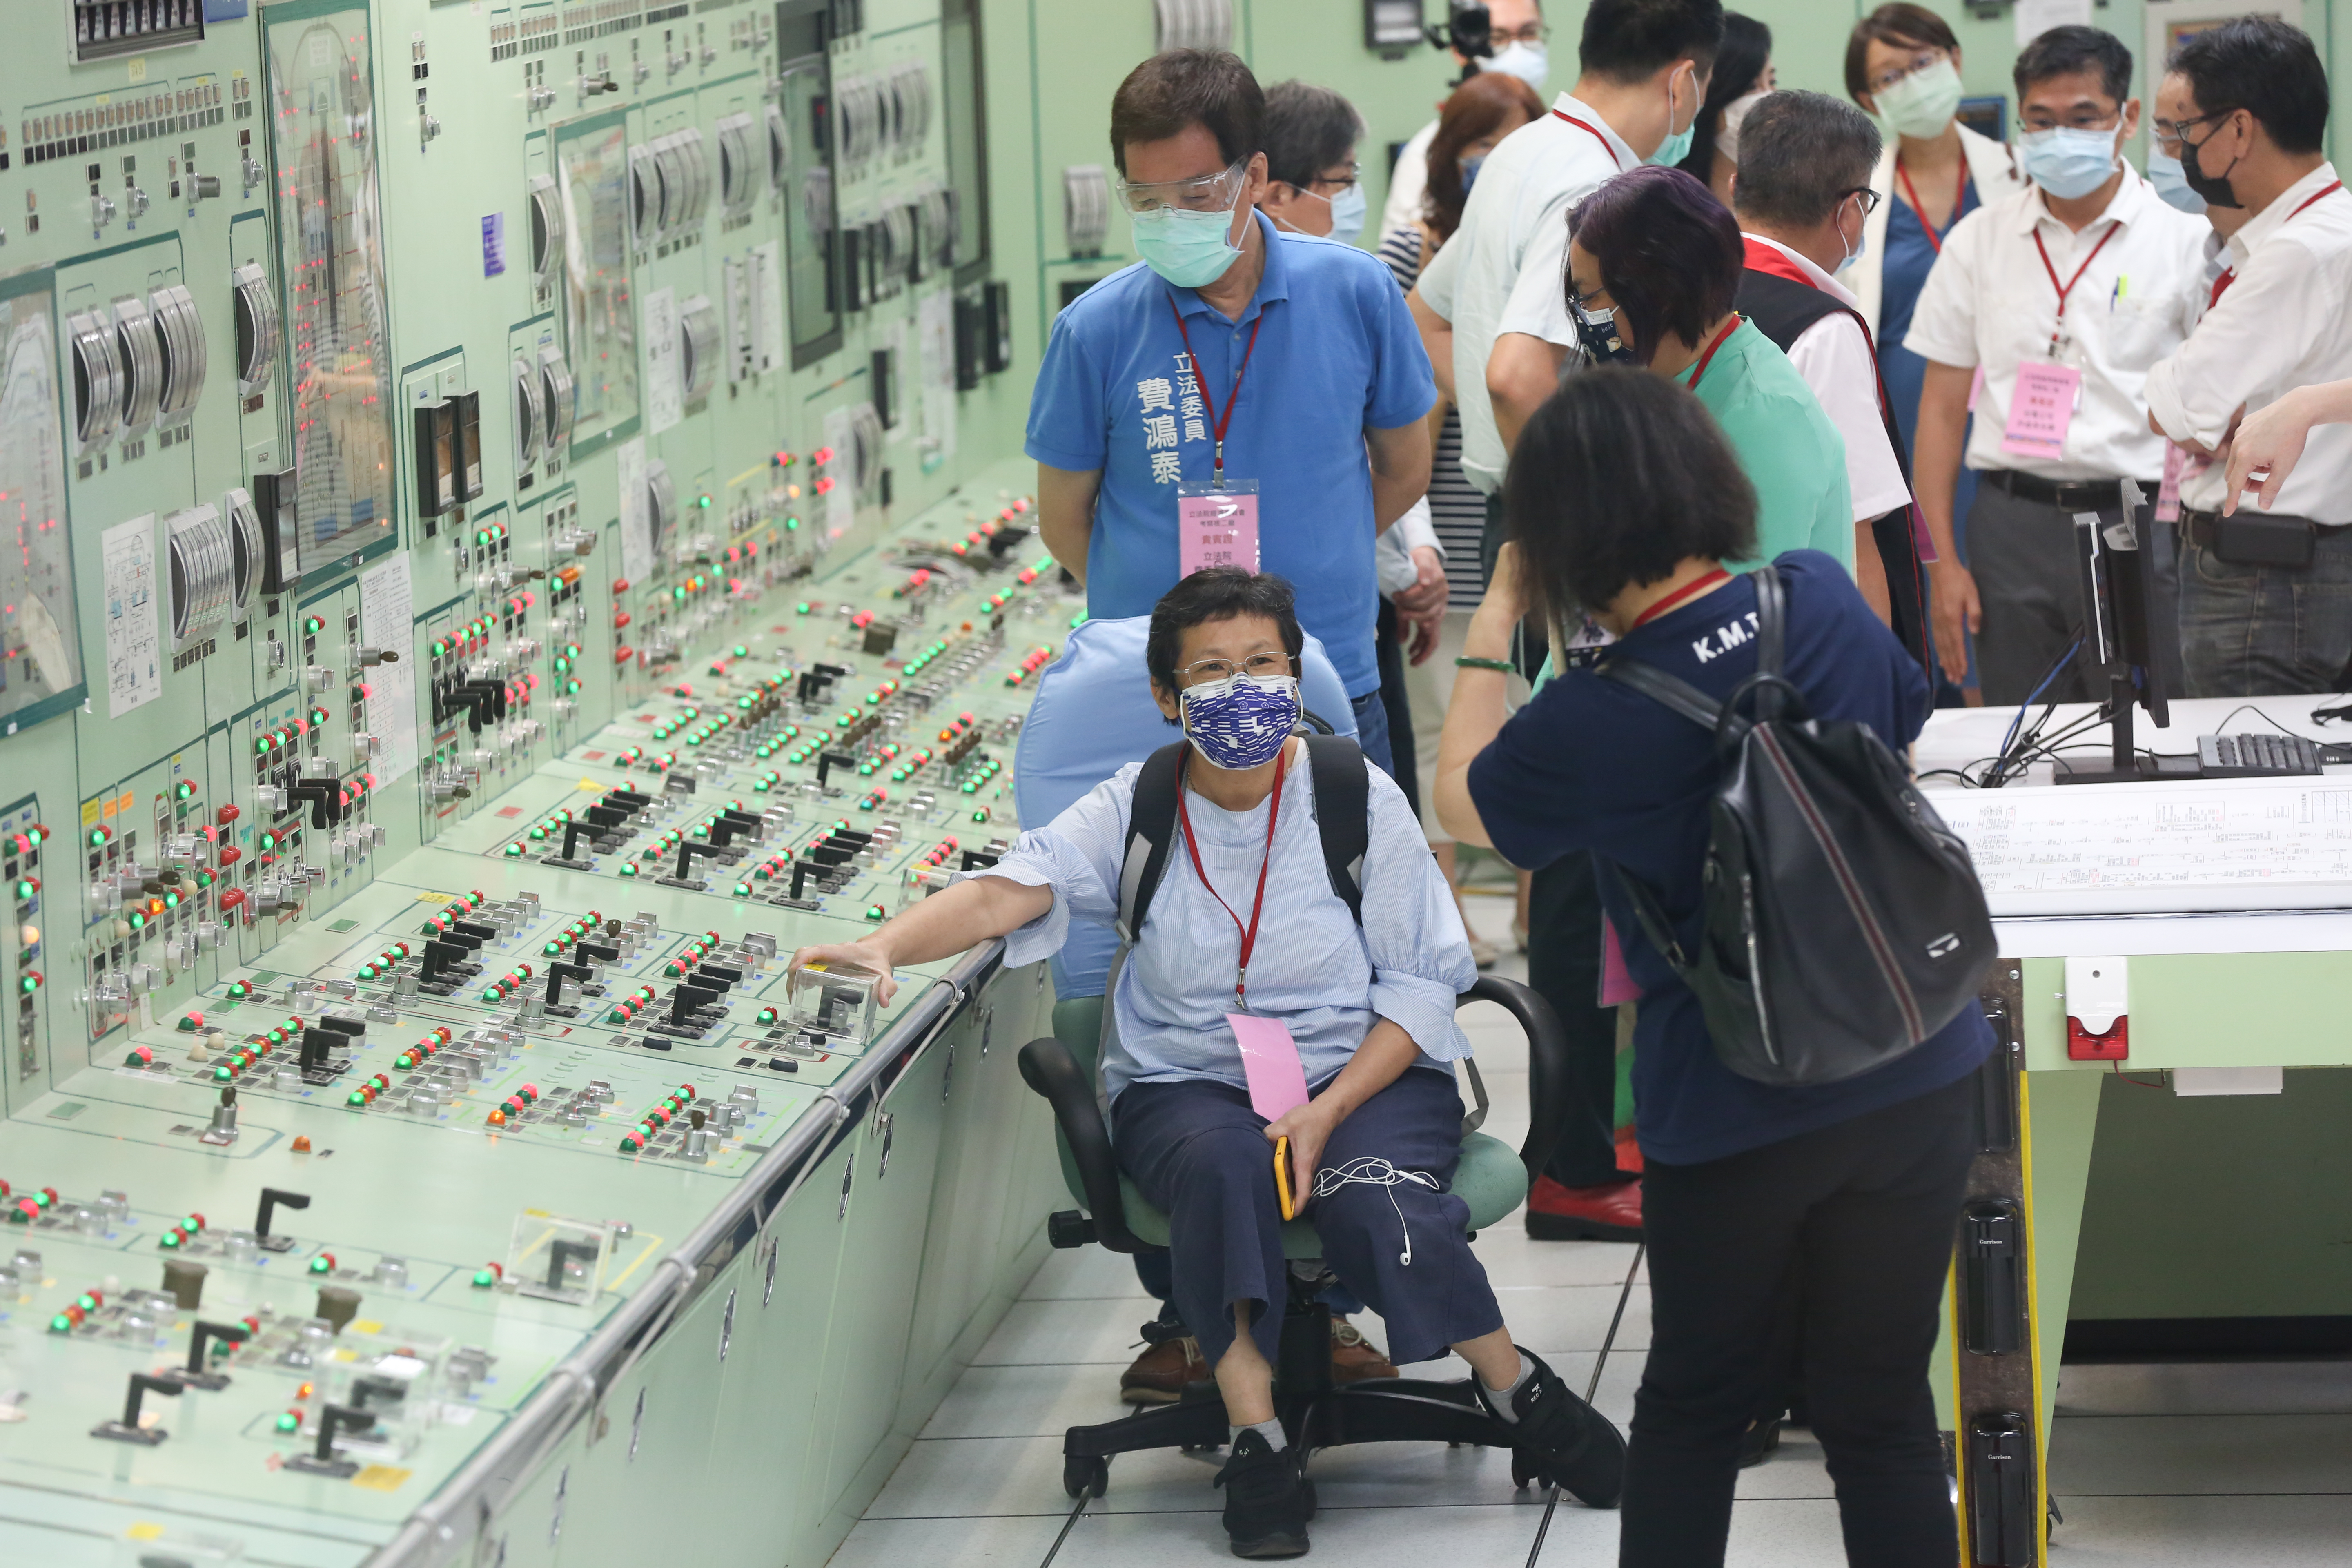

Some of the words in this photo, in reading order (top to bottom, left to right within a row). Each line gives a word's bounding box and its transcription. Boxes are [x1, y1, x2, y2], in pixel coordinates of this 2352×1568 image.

[1601, 323, 1614, 333] best
[1173, 352, 1207, 443] 立法委員
[1137, 377, 1181, 485] 費鴻泰
[1203, 551, 1232, 561] 立法院
[1530, 1393, 1539, 1403] RED
